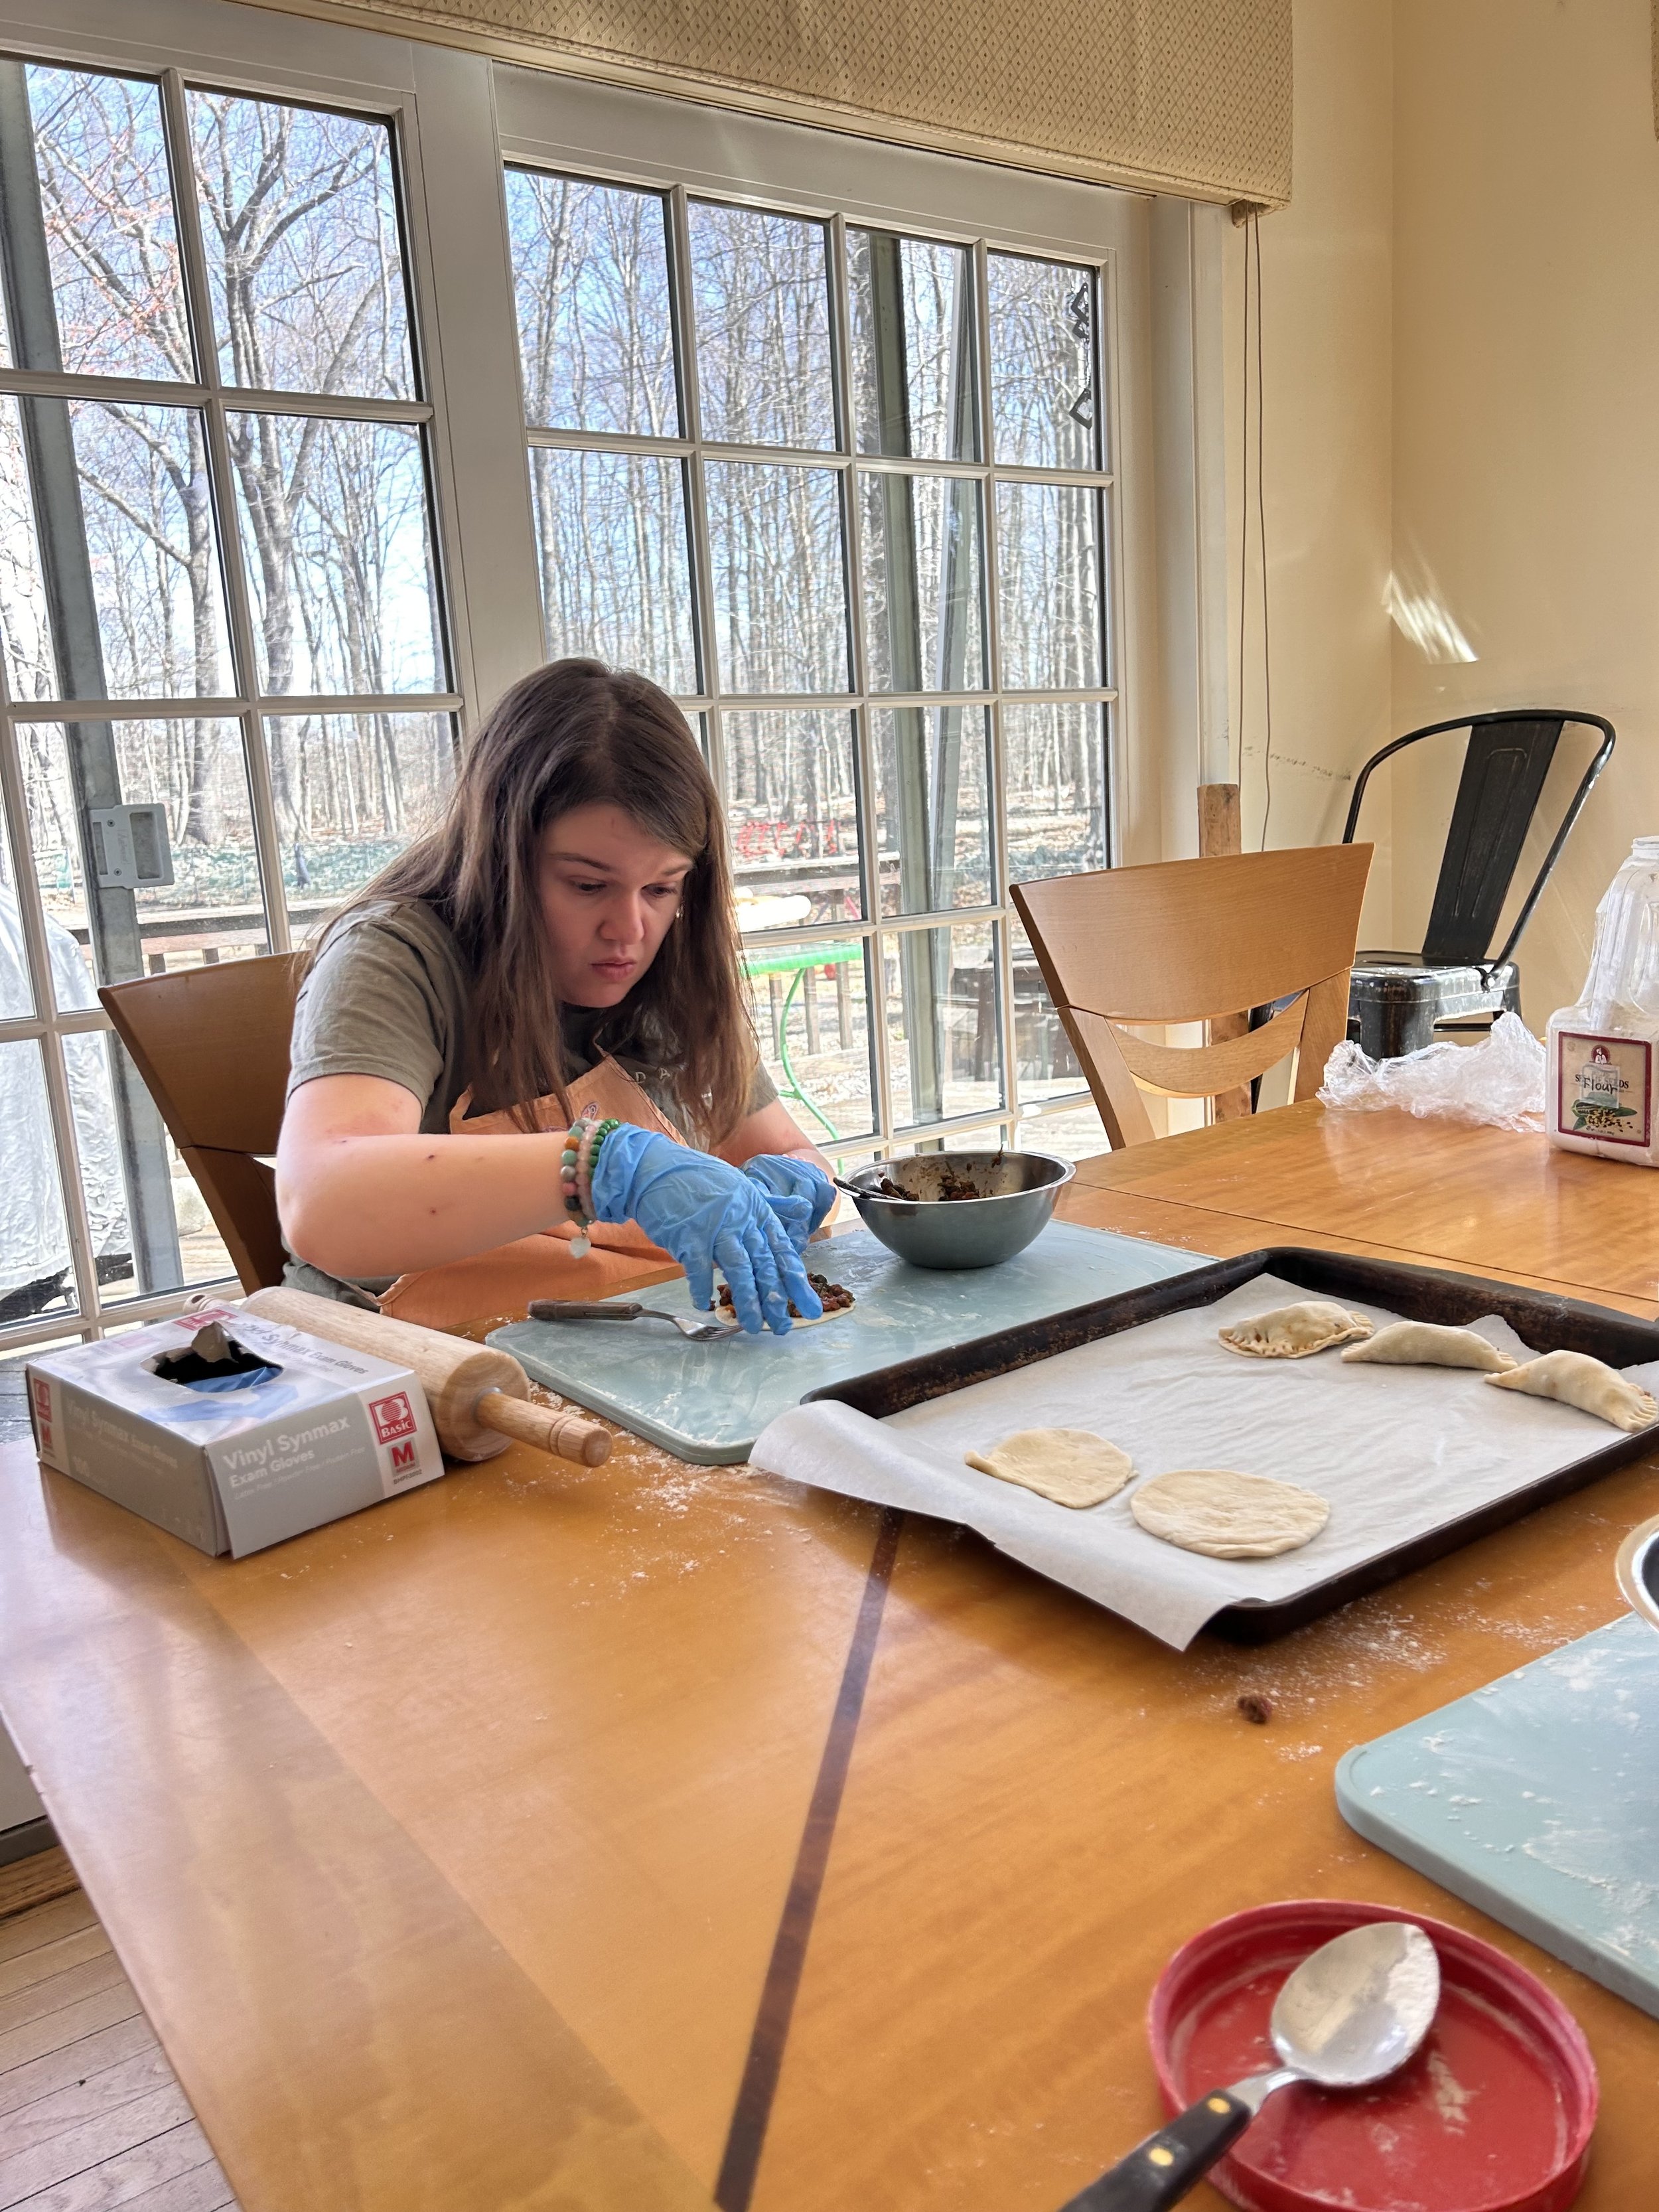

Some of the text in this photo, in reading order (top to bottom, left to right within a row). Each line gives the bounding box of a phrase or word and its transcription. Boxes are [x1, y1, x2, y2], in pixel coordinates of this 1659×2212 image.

[1583, 1077, 1618, 1095] Flour
[309, 1352, 336, 1364] Exam
[334, 1360, 369, 1374] Gloves
[223, 1417, 351, 1470] Vinyl Synmax
[391, 1440, 415, 1467] M
[228, 1449, 315, 1488] Exam Gloves
